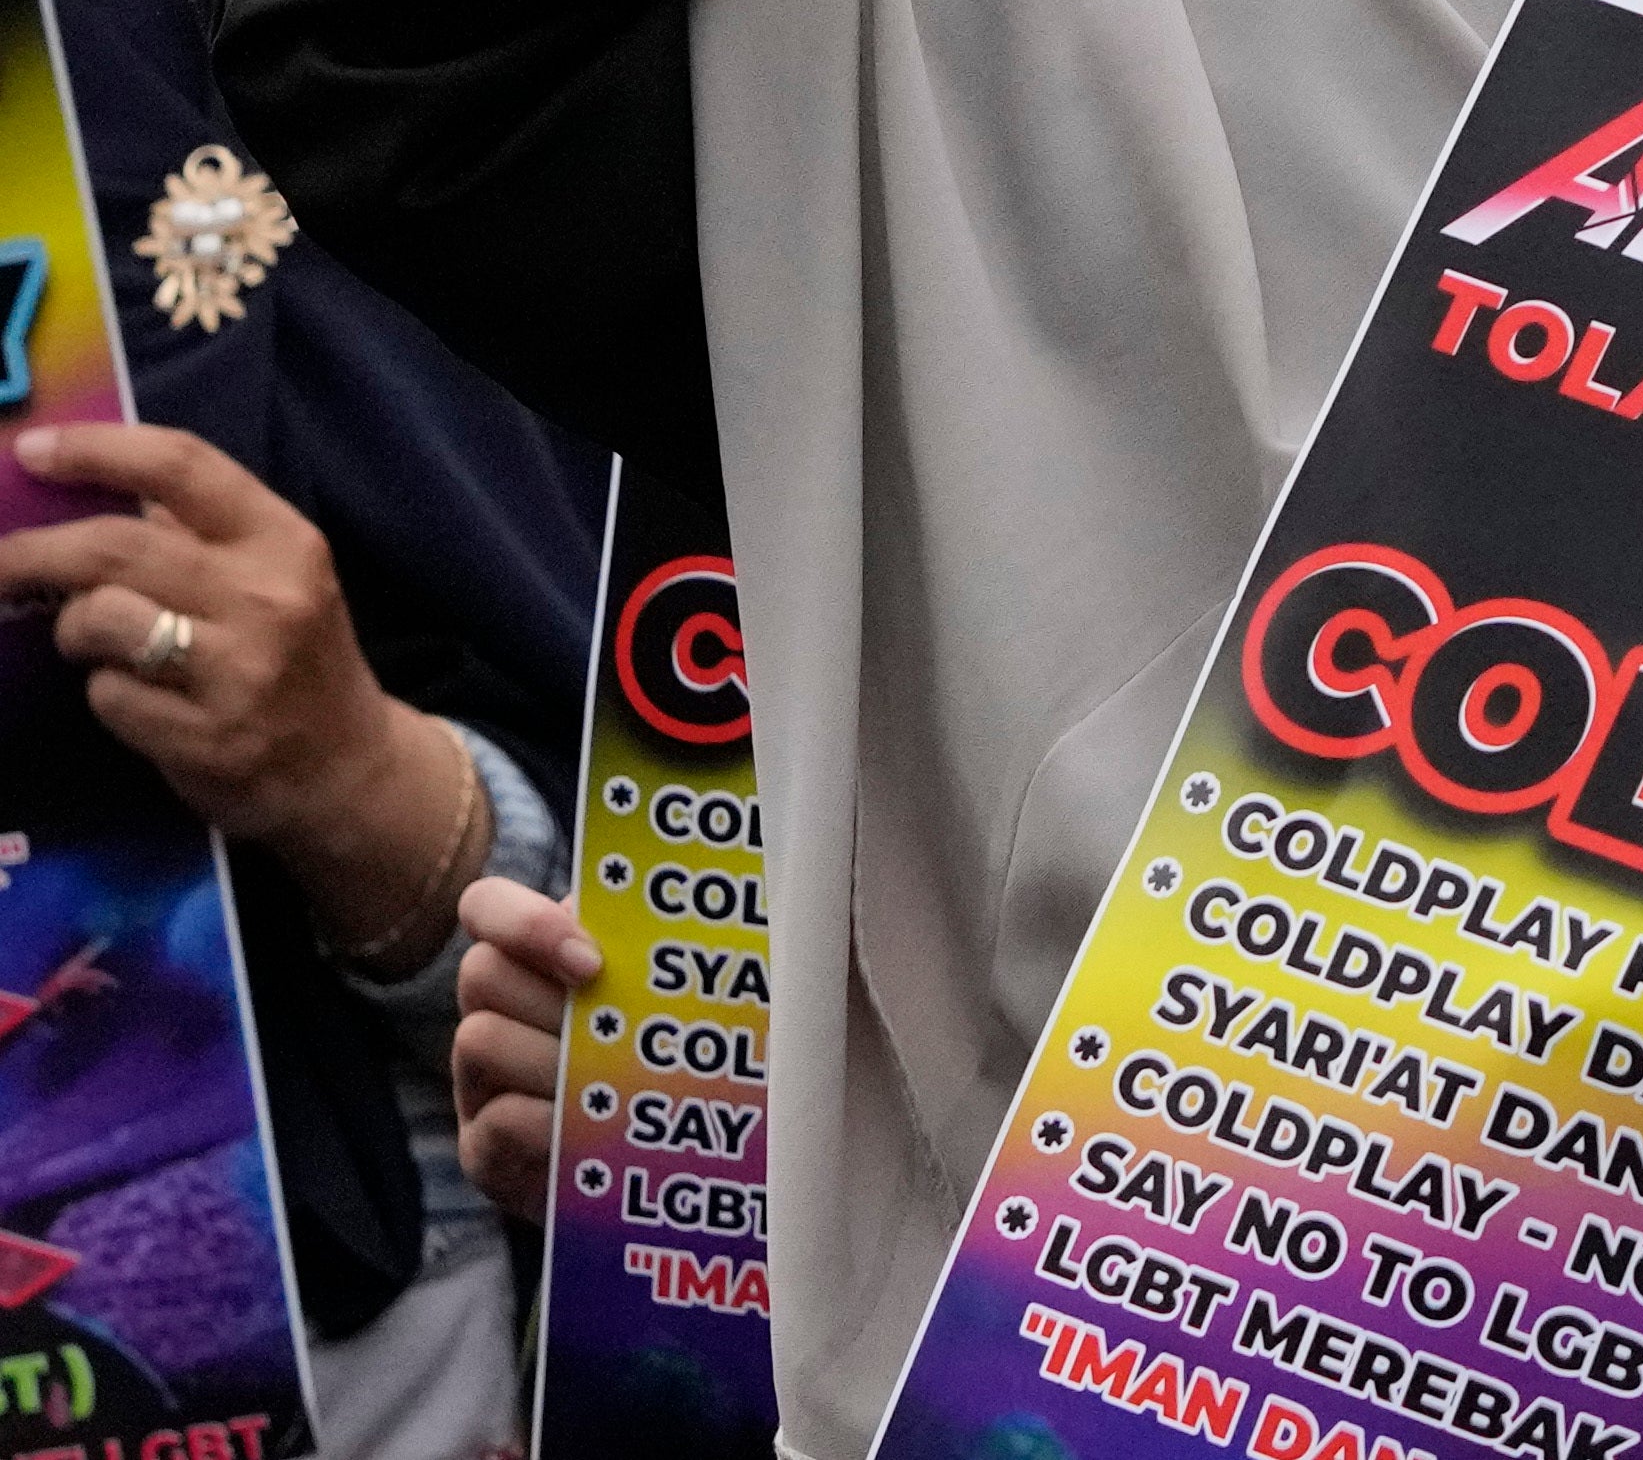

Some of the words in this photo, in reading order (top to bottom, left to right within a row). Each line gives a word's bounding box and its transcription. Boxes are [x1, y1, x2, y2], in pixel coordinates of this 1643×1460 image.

[1186, 880, 1584, 1060] COLDPLAY
[1221, 791, 1620, 976] COLDPLAY
[627, 1090, 762, 1161] SAY
[1153, 966, 1485, 1128] SYARI'AT
[1069, 1132, 1231, 1232] SAY
[1224, 1184, 1349, 1281] NO
[1360, 1234, 1477, 1329] TO
[1112, 1049, 1520, 1243] COLDPLAY
[1035, 1216, 1239, 1339] LGBT
[1232, 1289, 1640, 1460] MEREBAK
